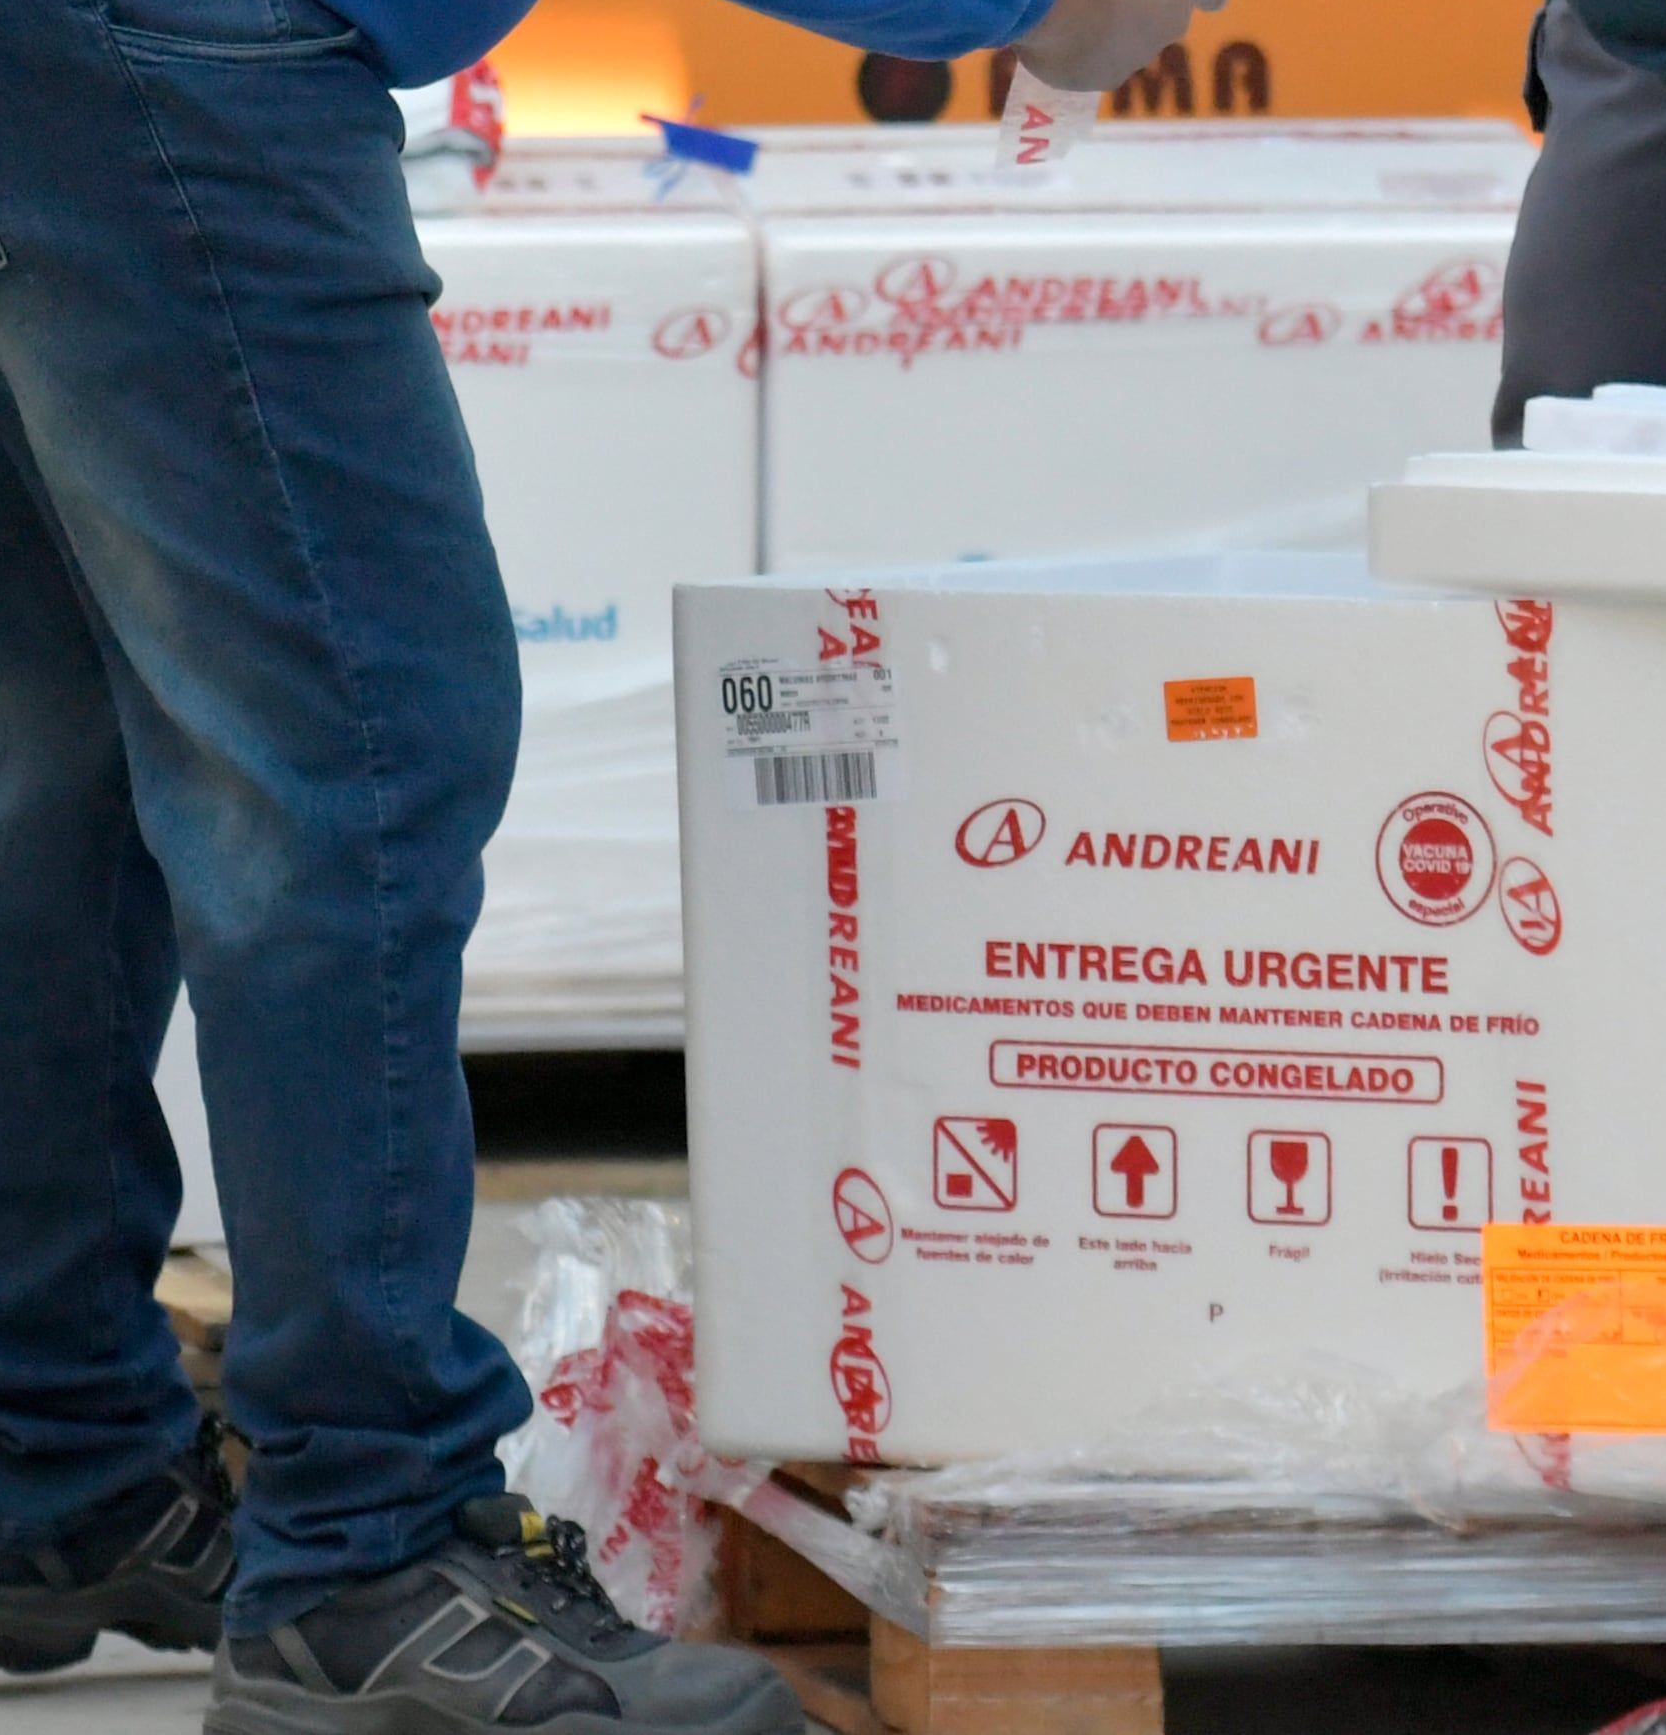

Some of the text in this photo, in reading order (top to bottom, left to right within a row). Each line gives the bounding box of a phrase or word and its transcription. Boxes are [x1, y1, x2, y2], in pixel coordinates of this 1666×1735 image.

[722, 675, 773, 714] 060
[1402, 804, 1469, 824] Operativo
[1065, 831, 1321, 875] ANDREANI
[1403, 844, 1469, 860] VACUNA
[1403, 859, 1453, 874] COVID
[1408, 897, 1466, 921] especial
[985, 940, 1450, 995] ENTREGA URGENTE
[896, 993, 1540, 1037] MEDICAMENTOS QUE DEBEN MANTENER CADENA DE FRÍO
[1016, 1052, 1415, 1095] PRODUCTO CONGELADO
[901, 1227, 1050, 1248] Mantener alejado de
[1078, 1236, 1193, 1255] Este lado hacia
[1560, 1231, 1621, 1246] CADENA
[1626, 1232, 1646, 1246] DE
[916, 1246, 1035, 1266] fuentes de calor
[1410, 1251, 1448, 1266] Hielo
